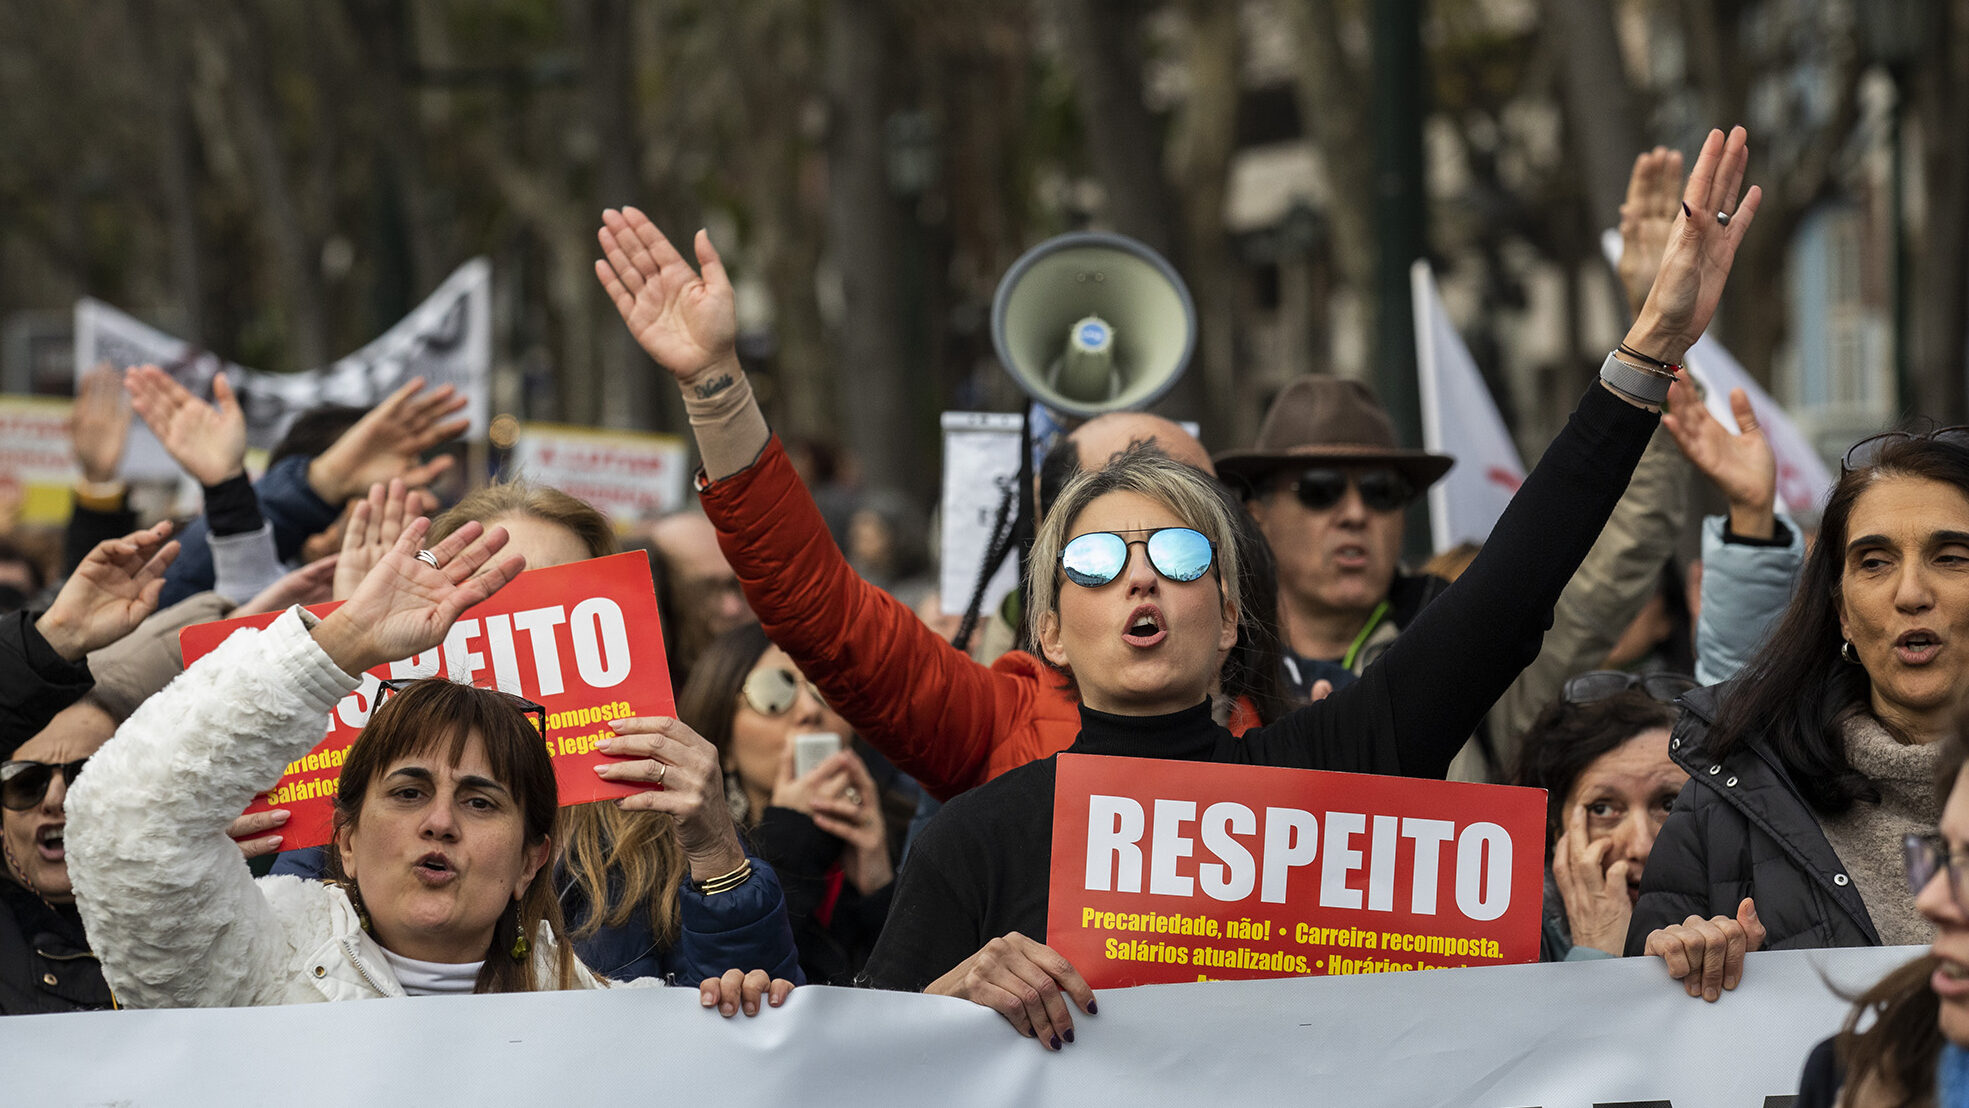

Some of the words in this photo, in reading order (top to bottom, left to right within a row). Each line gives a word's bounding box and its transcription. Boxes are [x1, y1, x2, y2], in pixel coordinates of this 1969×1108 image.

[1085, 794, 1513, 922] RESPEITO
[1082, 906, 1222, 940] Precariedade,
[1226, 917, 1271, 941] não!
[1295, 922, 1378, 949] Carreira
[1381, 932, 1504, 959] recomposta.
[1105, 937, 1189, 965] Salários
[1192, 946, 1311, 974] atualizados.
